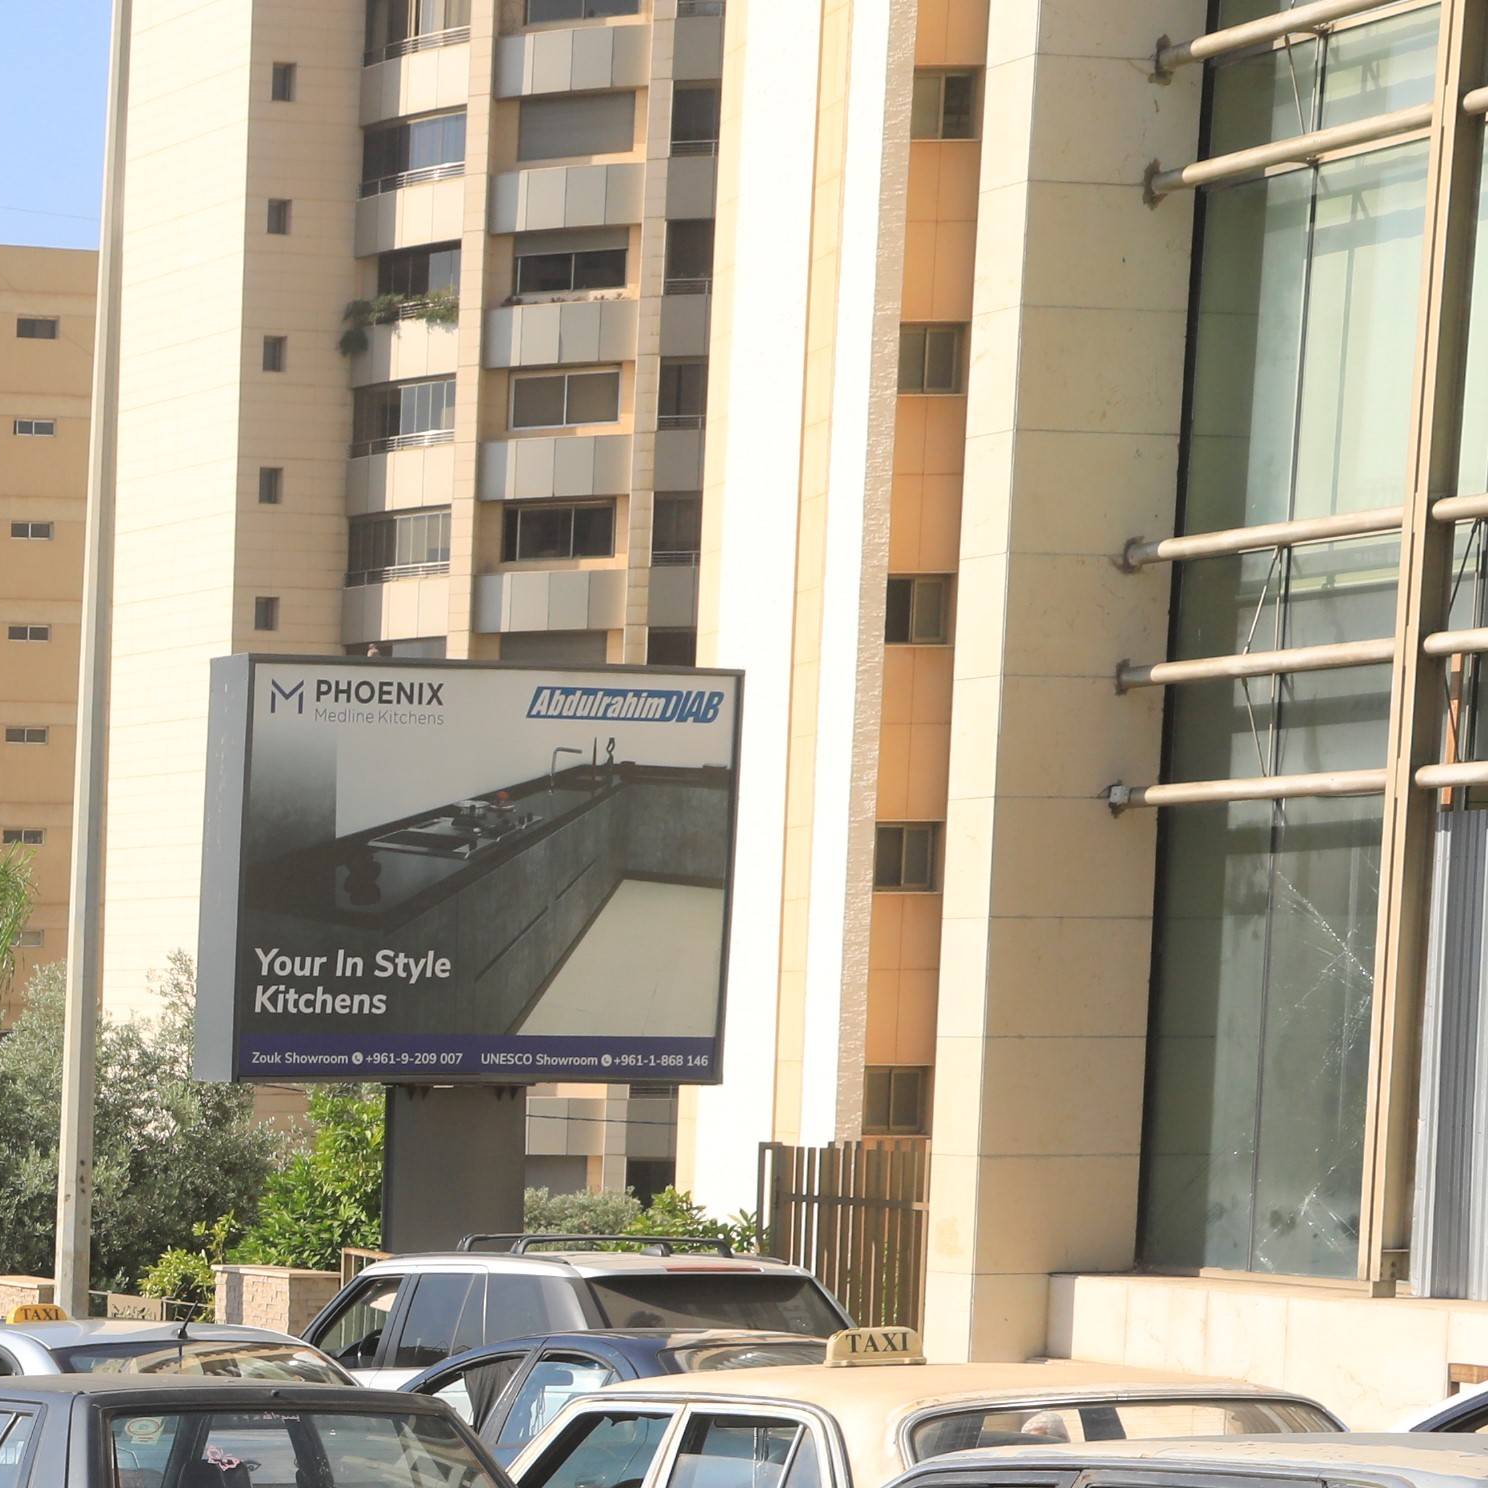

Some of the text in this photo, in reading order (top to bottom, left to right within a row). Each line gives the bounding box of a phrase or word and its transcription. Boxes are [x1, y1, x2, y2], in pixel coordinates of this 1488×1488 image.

[315, 678, 445, 706] PHOENIX
[530, 688, 666, 720] Abdulrahim
[314, 708, 445, 725] Medline Kitchens
[253, 947, 452, 984] Your In Style
[254, 985, 387, 1015] Kitchens
[251, 1051, 463, 1065] Zouk Showroom +961-9-209 007
[480, 1053, 708, 1067] UNESCO Showroom +961-1-868 146
[20, 1308, 59, 1320] TAXI
[845, 1332, 909, 1353] TAXI
